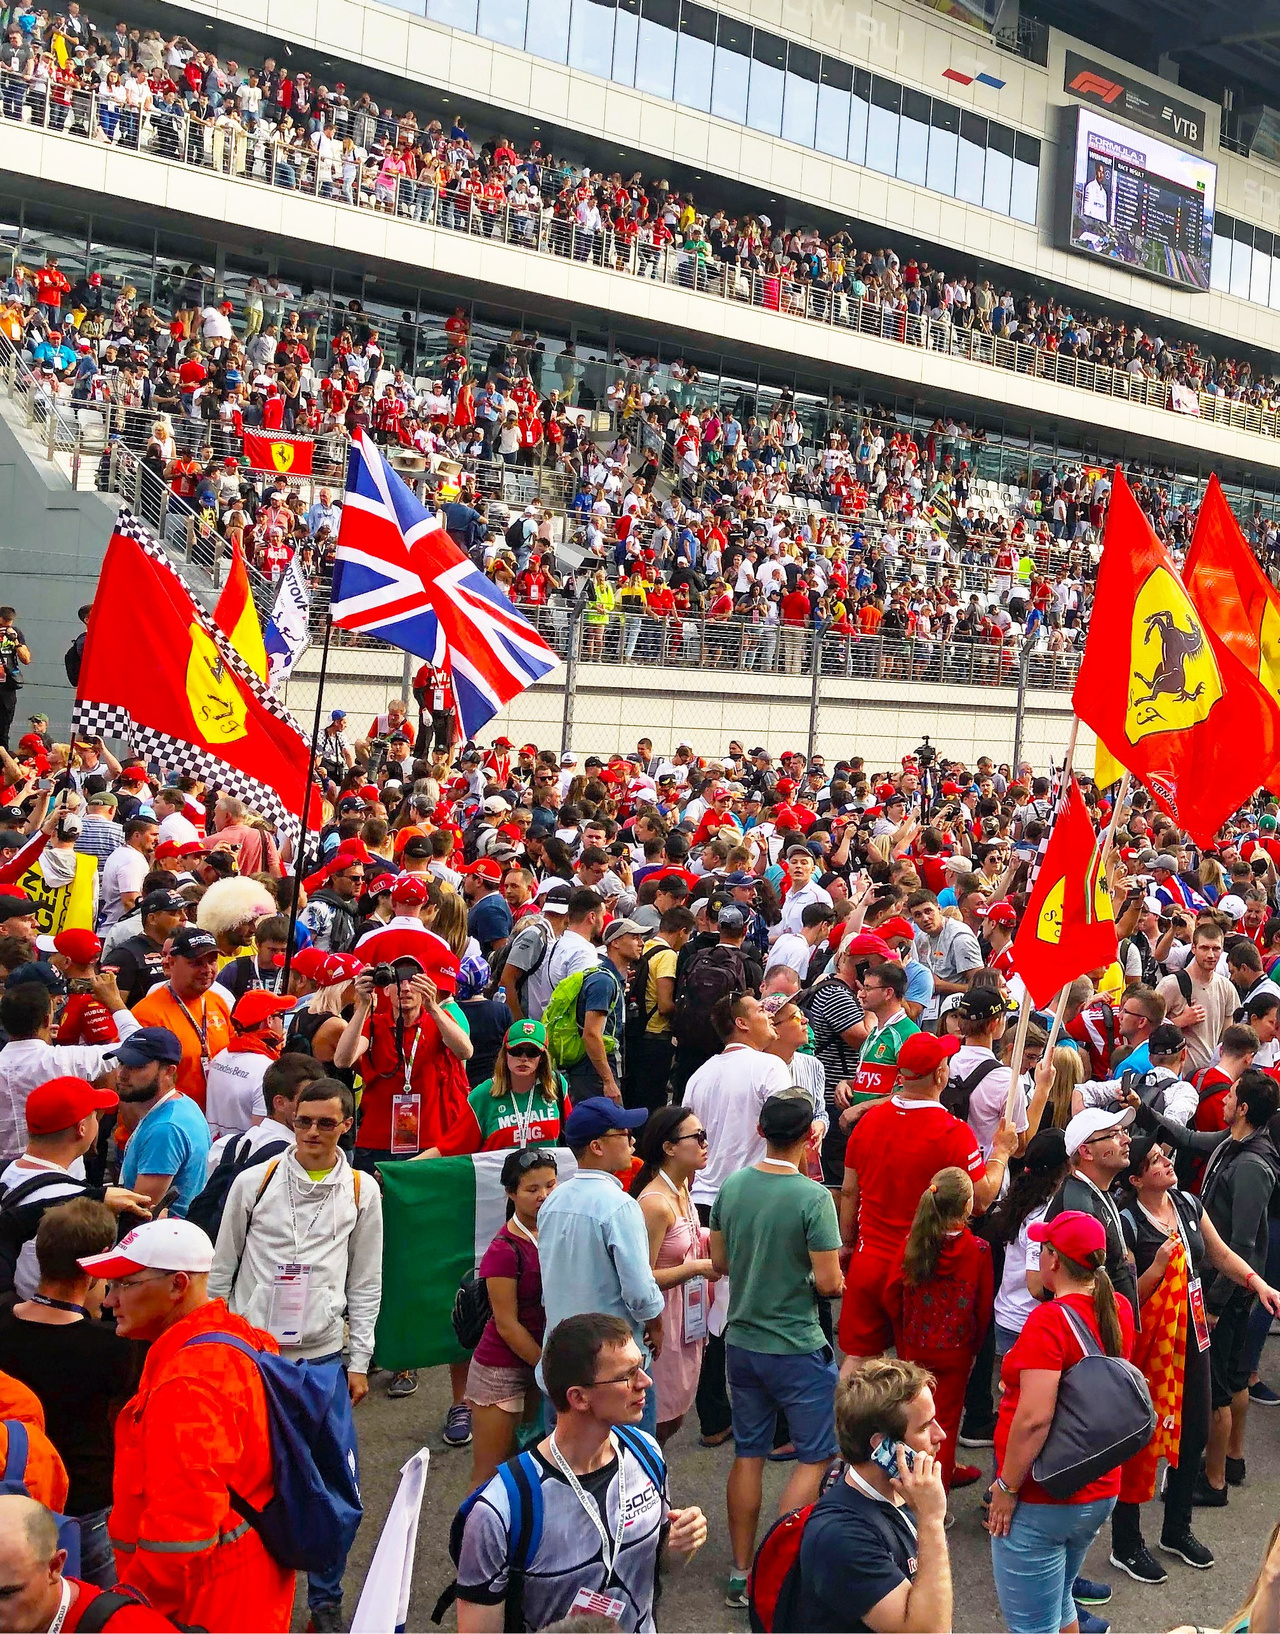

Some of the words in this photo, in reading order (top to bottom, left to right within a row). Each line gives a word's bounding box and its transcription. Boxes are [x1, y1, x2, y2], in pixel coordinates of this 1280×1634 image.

[1172, 113, 1198, 141] VTB
[1089, 134, 1138, 159] FORMULA
[624, 1483, 659, 1513] SOCH
